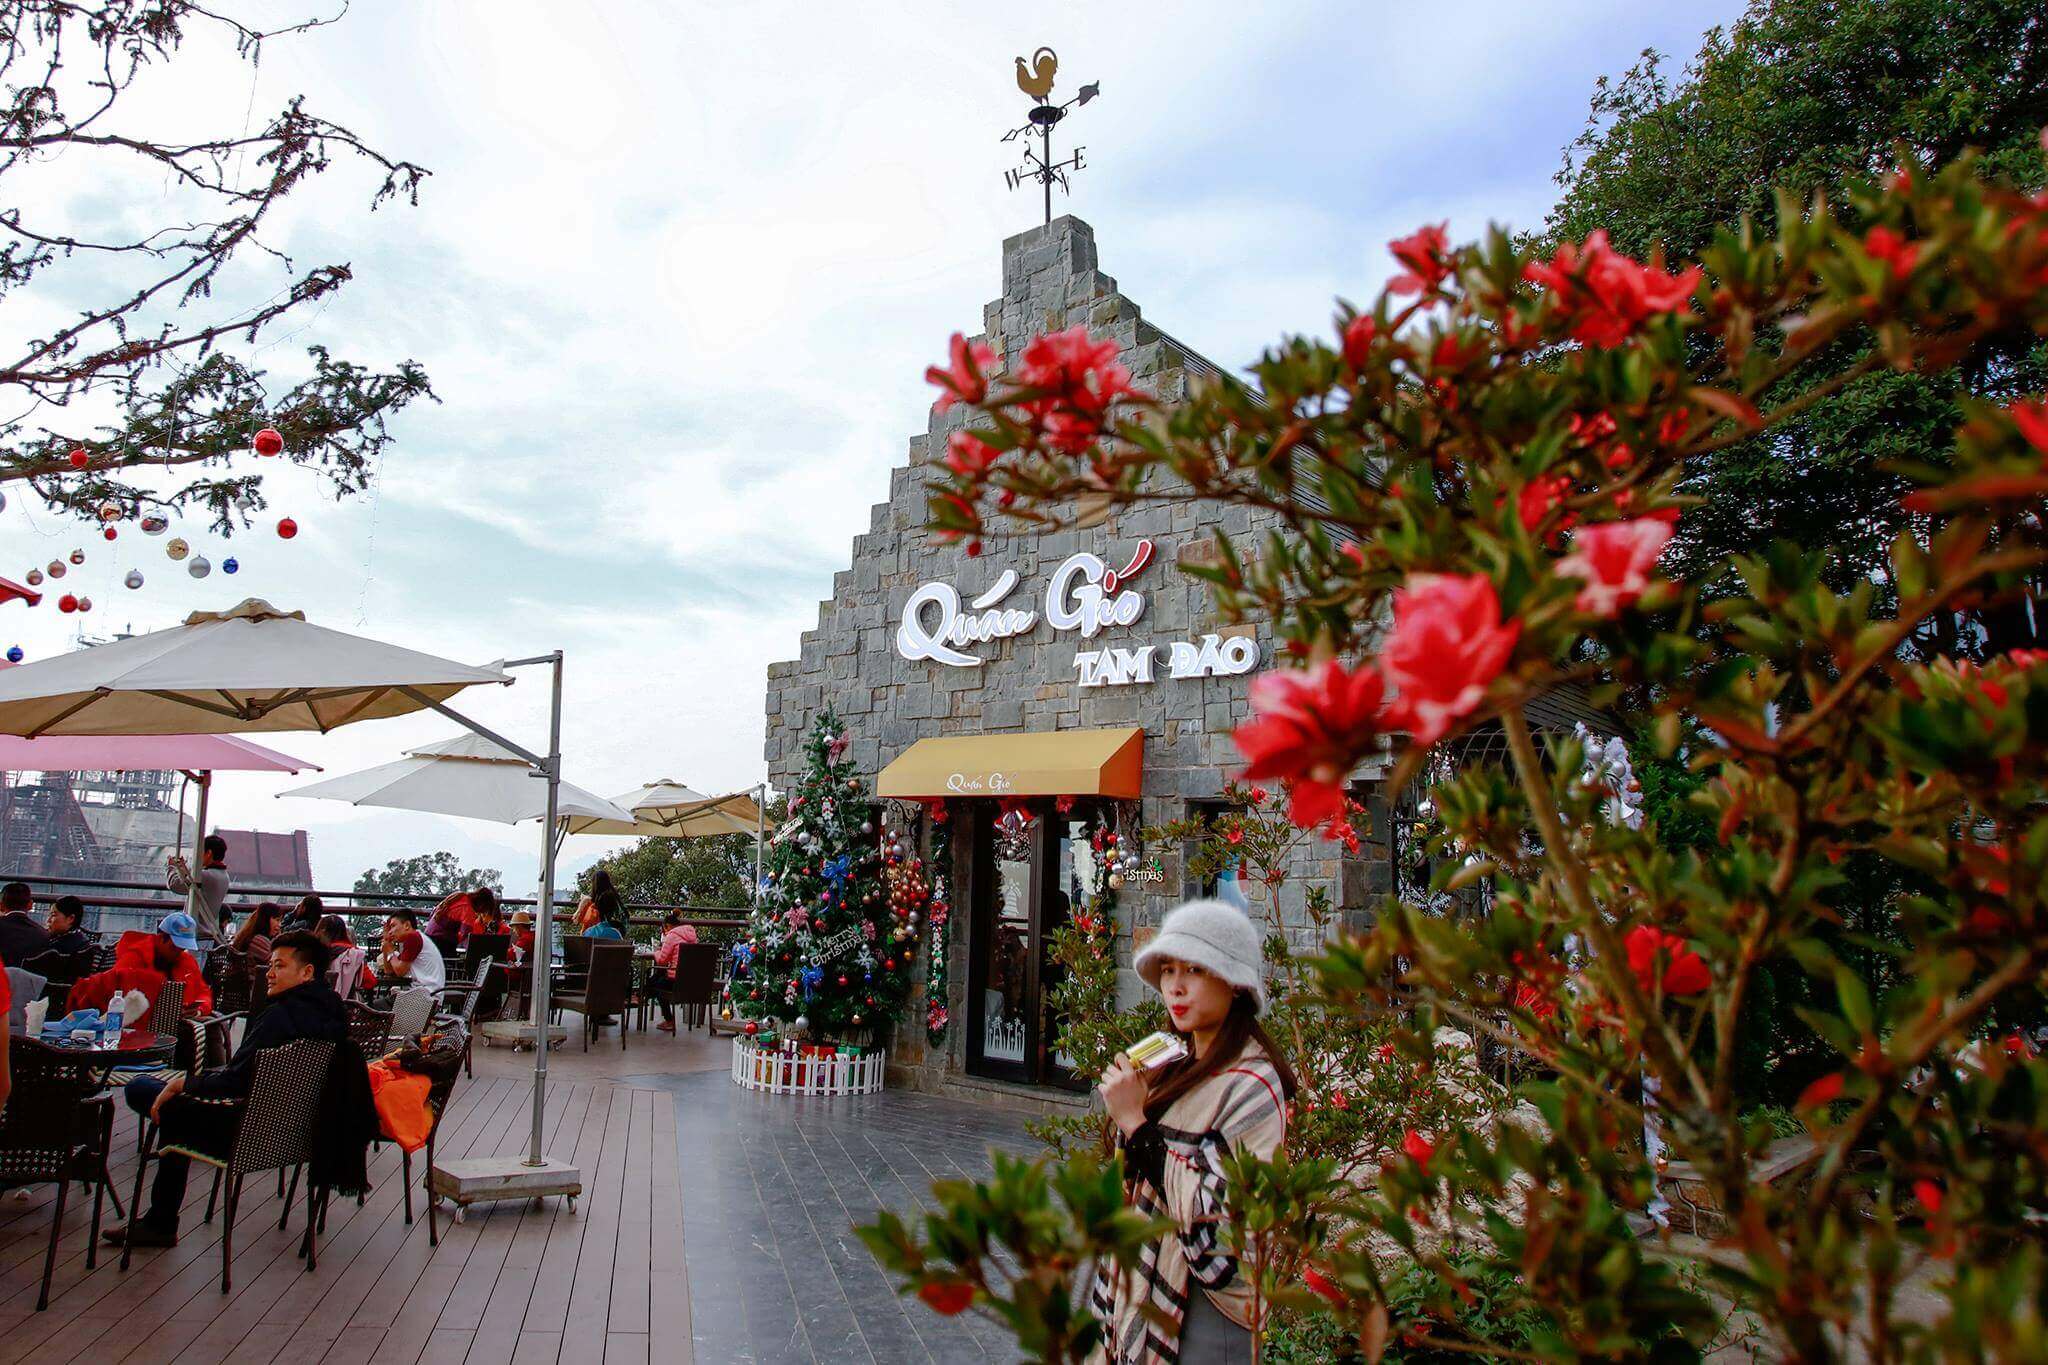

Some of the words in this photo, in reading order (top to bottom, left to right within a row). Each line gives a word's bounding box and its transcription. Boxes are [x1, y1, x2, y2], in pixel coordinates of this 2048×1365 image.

[1074, 146, 1087, 171] E
[1004, 165, 1022, 192] W
[897, 569, 1038, 667] Quán
[1046, 539, 1157, 638] Gió
[1073, 645, 1156, 687] TAM
[1125, 868, 1163, 883] istmas
[810, 934, 869, 967] Christmas
[816, 924, 861, 952] Merry
